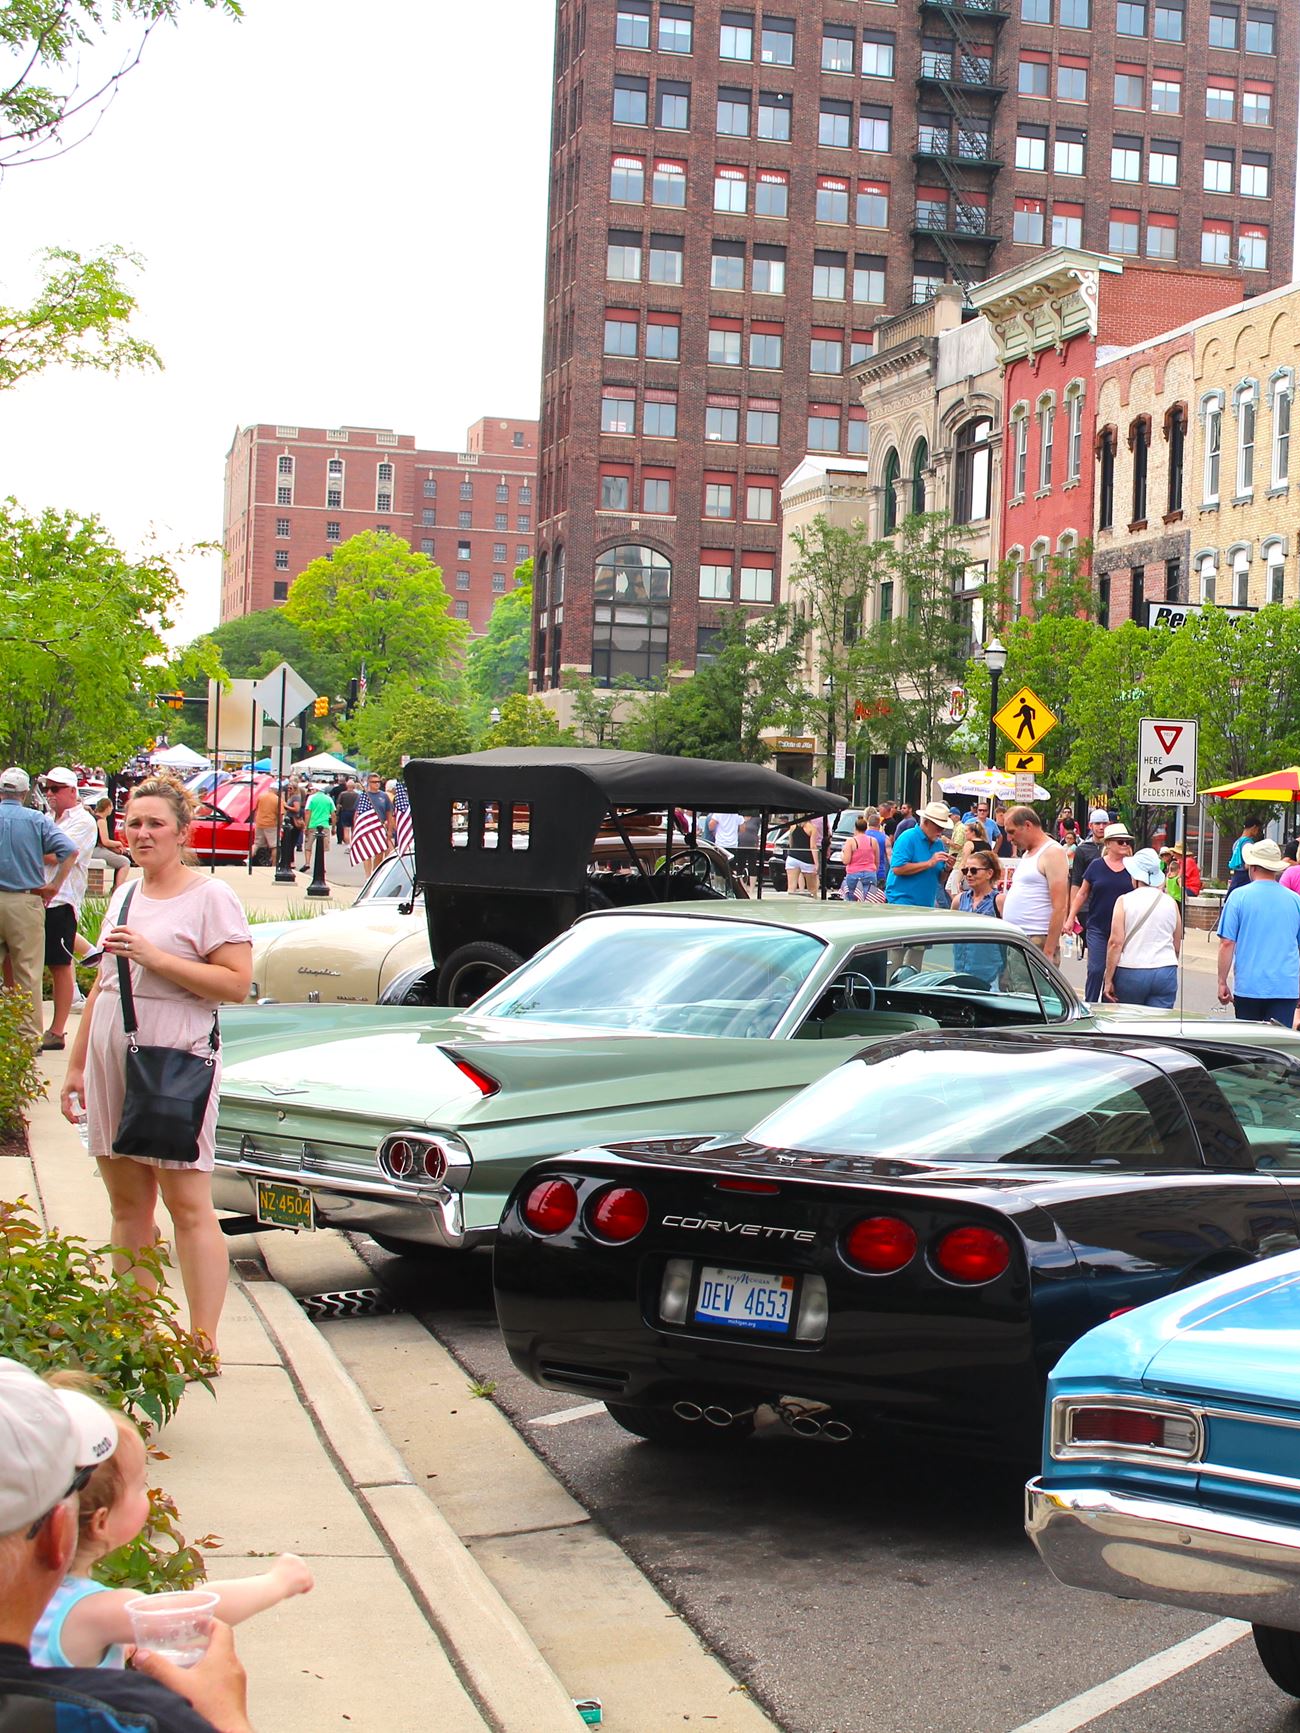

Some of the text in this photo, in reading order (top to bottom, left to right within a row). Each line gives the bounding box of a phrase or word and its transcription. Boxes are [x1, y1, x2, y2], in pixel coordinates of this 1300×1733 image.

[1144, 757, 1163, 765] HERE
[1175, 777, 1184, 786] TO
[1142, 788, 1191, 798] PEDESTRIANS
[260, 1190, 311, 1217] NZ 4504
[661, 1215, 817, 1242] CORVETTE
[701, 1281, 788, 1320] DEV 4653
[727, 1319, 757, 1328] michigan.org
